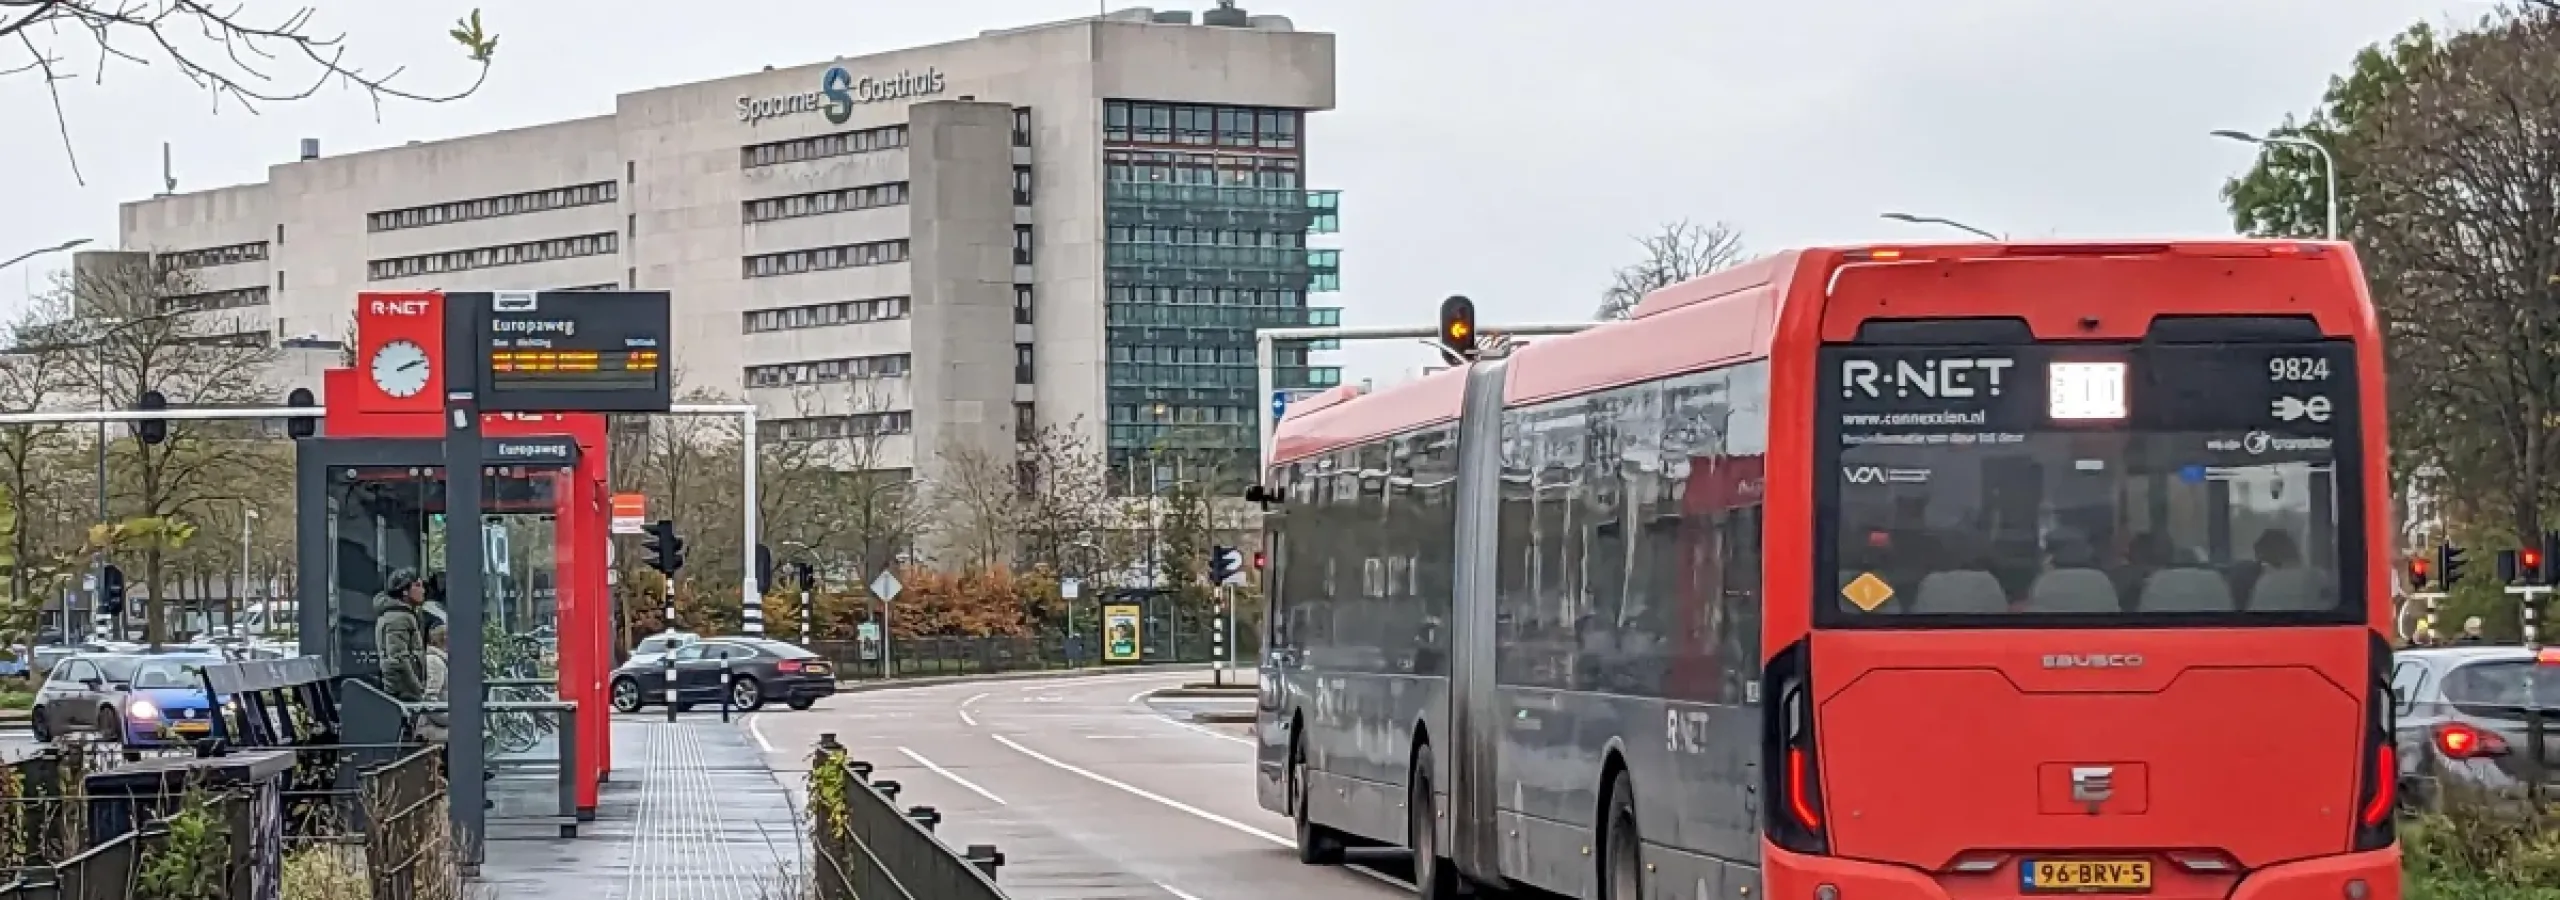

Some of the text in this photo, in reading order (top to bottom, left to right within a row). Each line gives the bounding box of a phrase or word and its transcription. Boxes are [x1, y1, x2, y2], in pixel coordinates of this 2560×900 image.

[735, 89, 822, 127] Spaarne
[857, 66, 945, 101] Gasthuis
[492, 319, 575, 336] Europaweg
[2270, 357, 2331, 381] 9824
[1842, 410, 1985, 425] www.connexxion.nl
[499, 443, 566, 456] Europaweg
[2043, 654, 2143, 667] EBUSCO
[2040, 863, 2145, 883] 96-BRV-5
